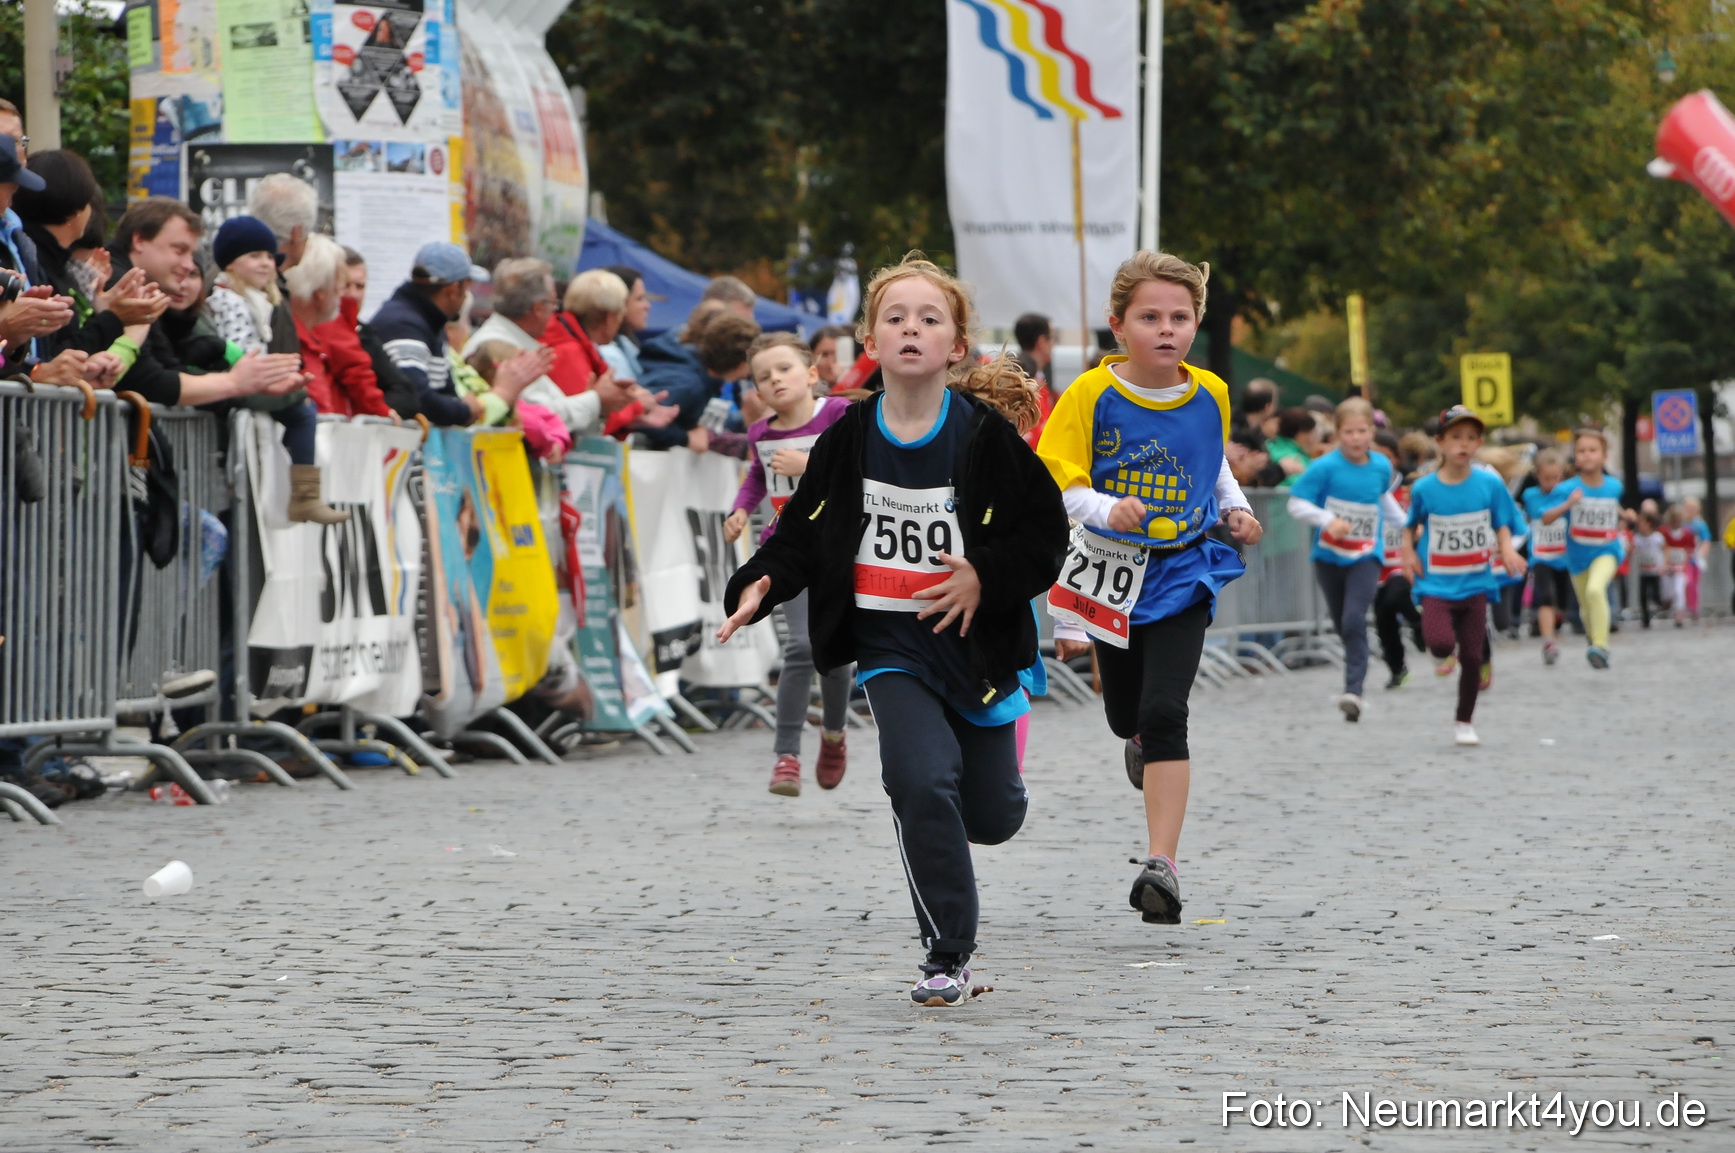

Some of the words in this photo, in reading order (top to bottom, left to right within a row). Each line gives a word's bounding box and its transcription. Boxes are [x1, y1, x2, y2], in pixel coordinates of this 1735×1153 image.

[1475, 376, 1499, 408] D
[882, 496, 939, 514] Neumarkt
[1165, 505, 1184, 513] 2014
[855, 512, 952, 567] 7569
[1435, 526, 1486, 551] 7536
[1084, 539, 1128, 562] Neumarkt
[1072, 596, 1097, 619] Jule
